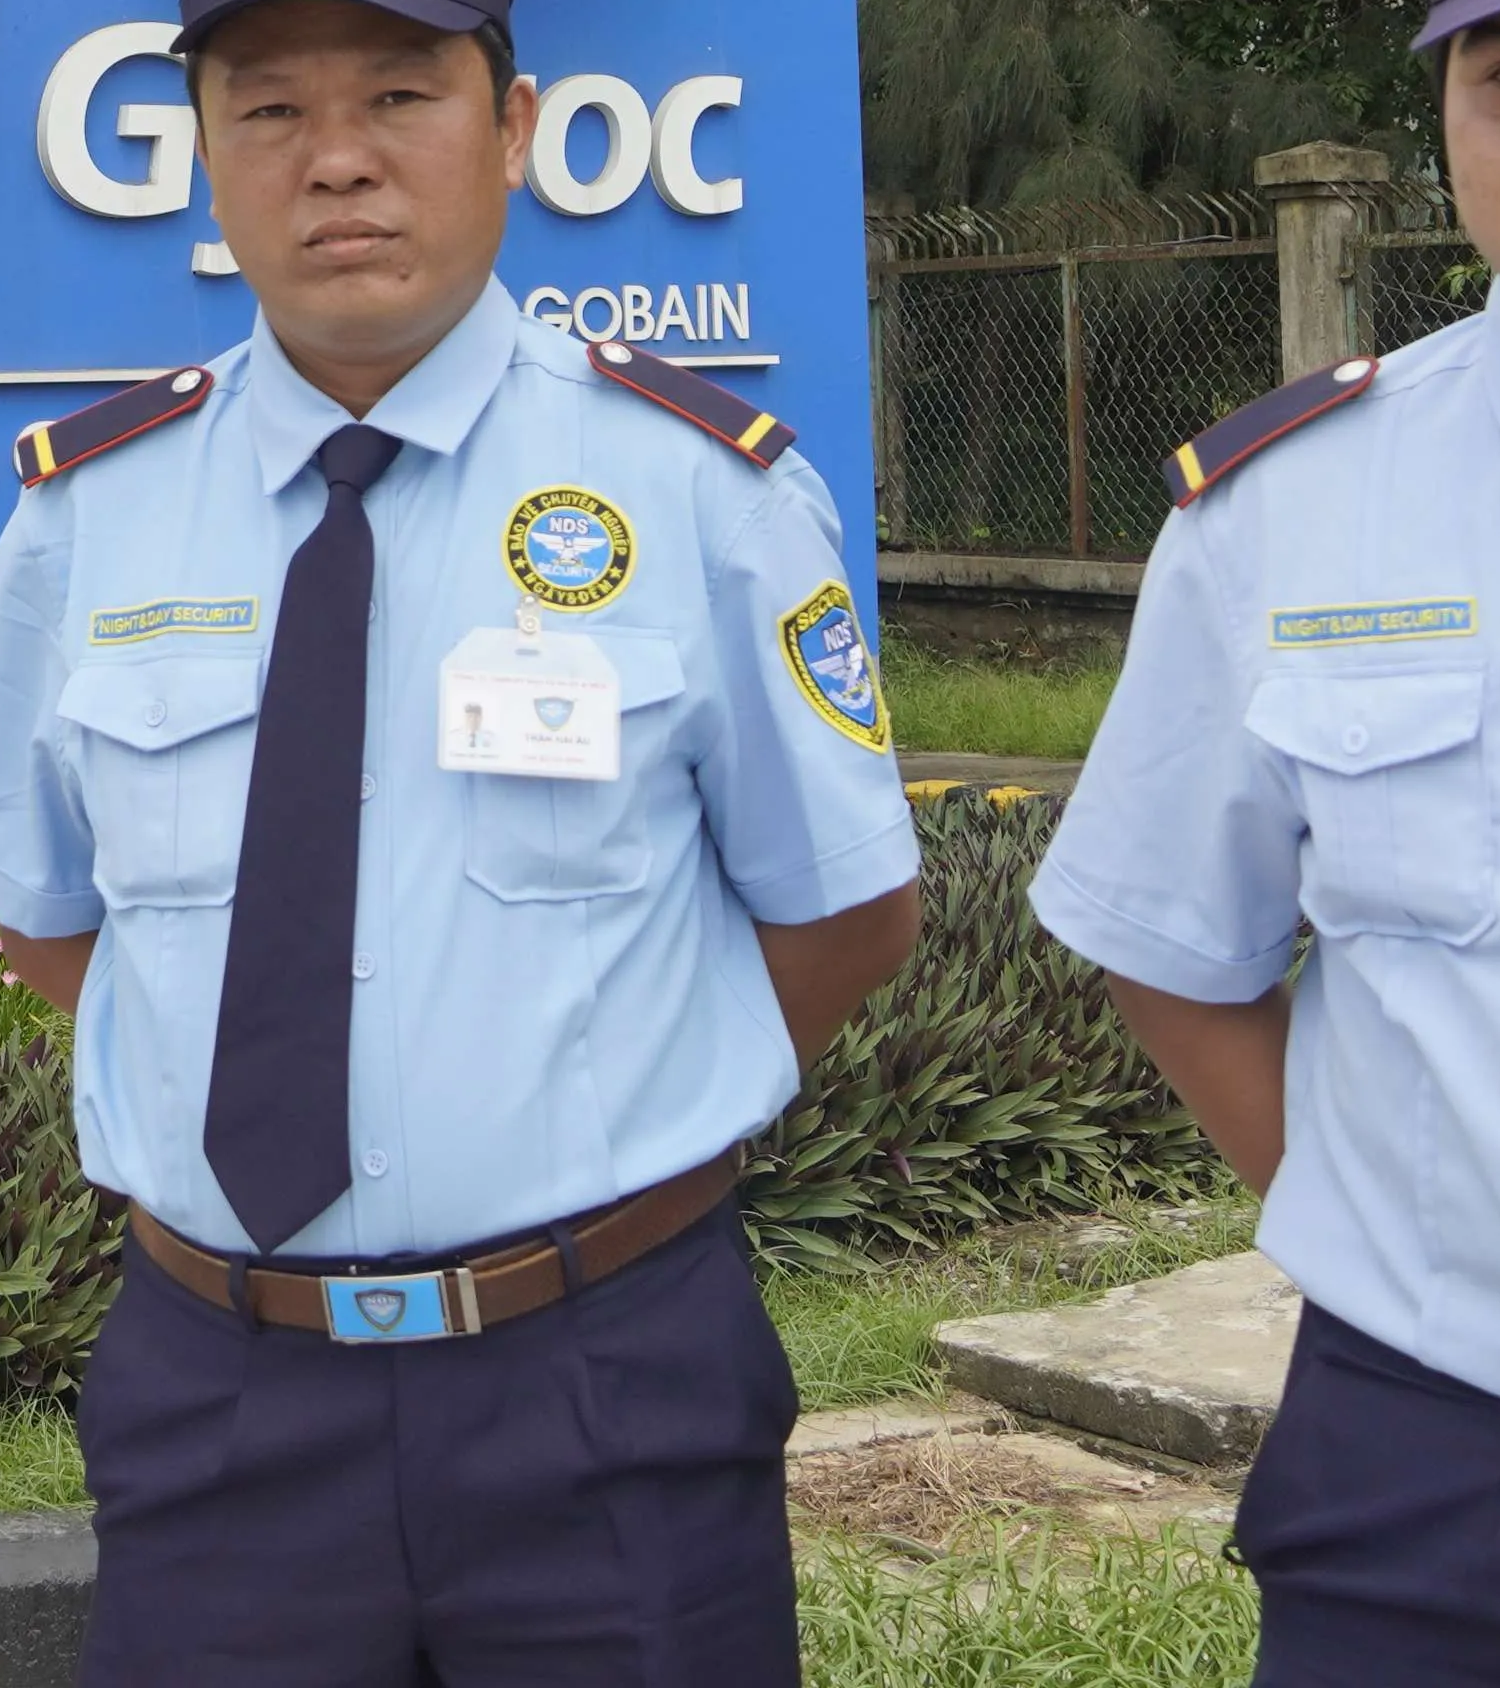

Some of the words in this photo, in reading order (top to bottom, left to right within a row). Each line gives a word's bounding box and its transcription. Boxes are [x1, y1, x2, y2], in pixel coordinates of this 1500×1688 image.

[549, 515, 590, 535] NDS
[172, 606, 249, 624] SECURITY
[1378, 607, 1465, 631] SECURITY
[822, 622, 853, 653] NDS
